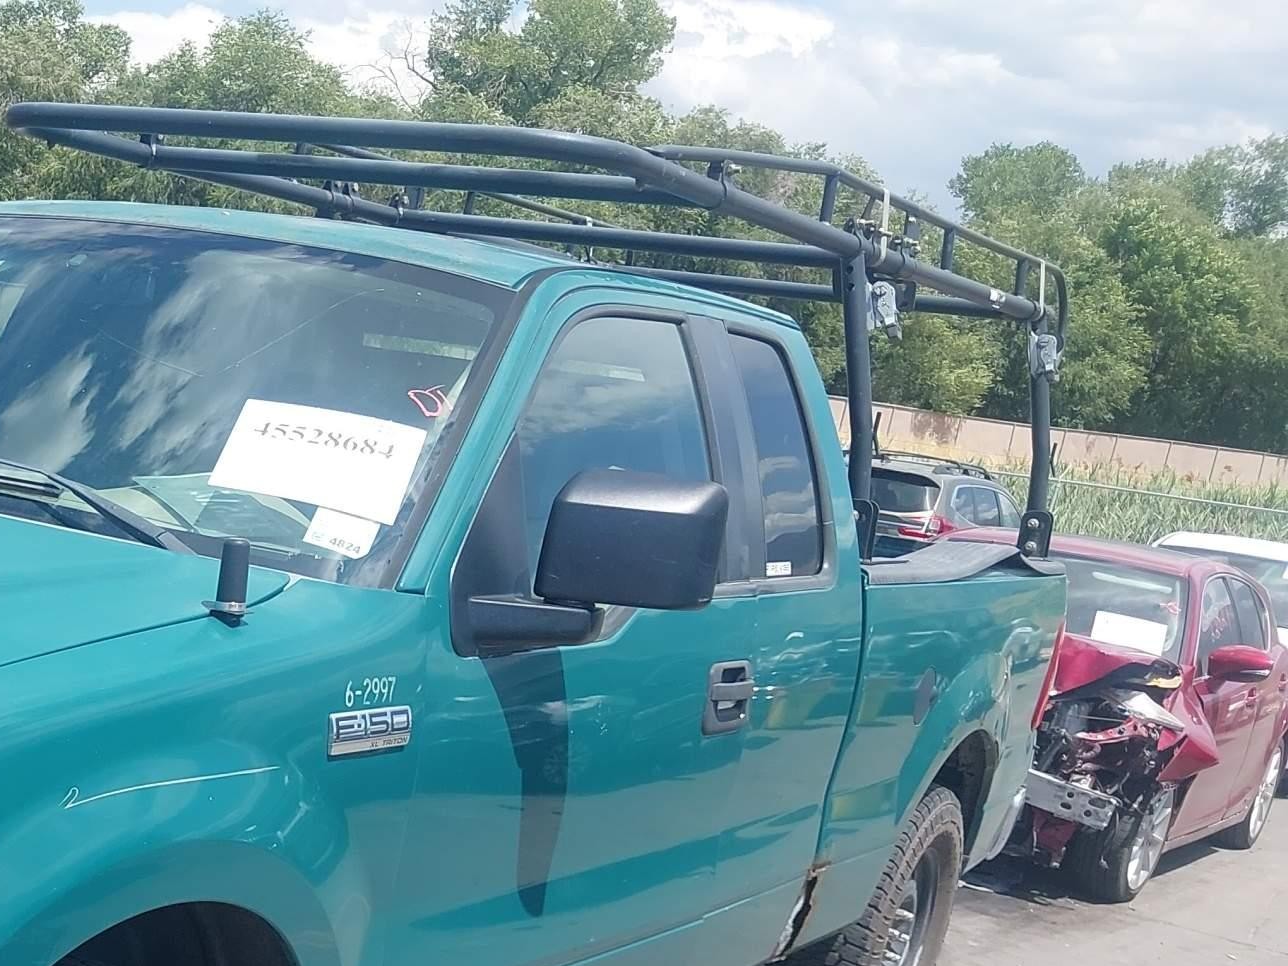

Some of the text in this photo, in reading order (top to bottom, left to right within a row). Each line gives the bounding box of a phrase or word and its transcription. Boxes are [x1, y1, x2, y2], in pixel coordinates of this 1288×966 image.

[253, 421, 395, 460] 45528684
[329, 534, 362, 555] 4824
[344, 676, 397, 708] 6-2997
